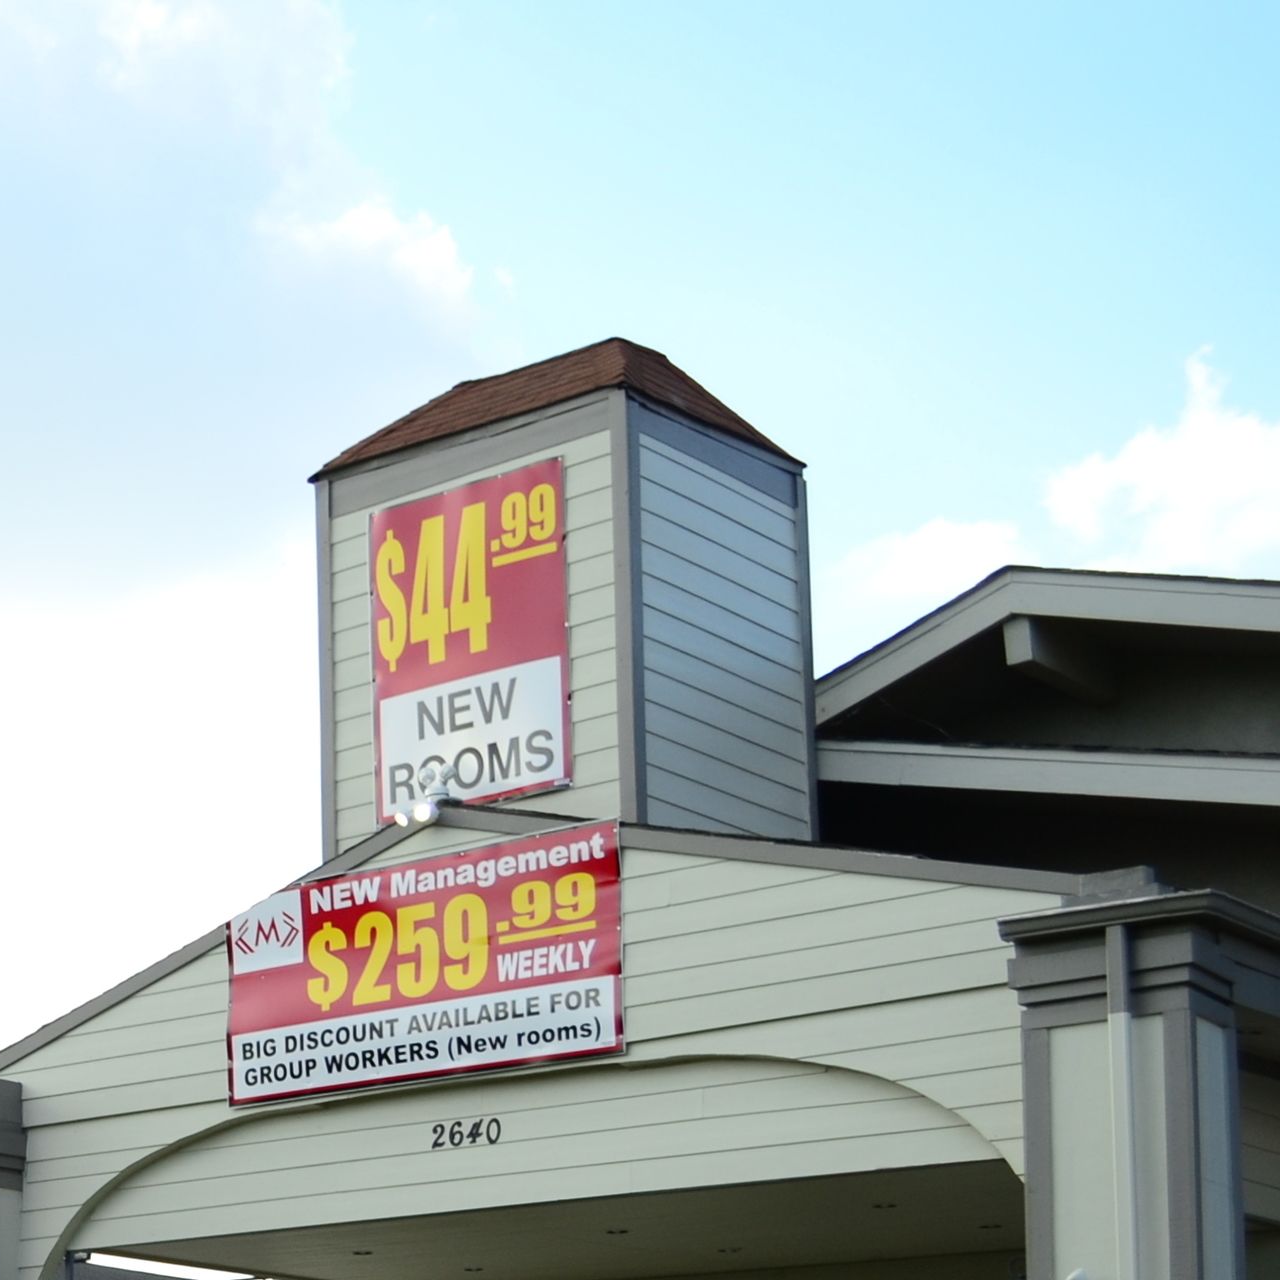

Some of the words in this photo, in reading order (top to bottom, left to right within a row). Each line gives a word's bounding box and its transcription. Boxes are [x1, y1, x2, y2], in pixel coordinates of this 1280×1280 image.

[417, 677, 517, 740] NEW
[309, 876, 381, 914] NEW
[389, 832, 606, 898] Management
[496, 939, 597, 983] WEEKLY
[242, 1037, 277, 1061] BIG
[284, 1018, 400, 1054] DISCOUNT
[407, 996, 540, 1035] AVAILABLE
[549, 988, 601, 1014] FOR
[244, 1059, 318, 1087] GROUP
[325, 1040, 440, 1074] WORKERS
[447, 1032, 508, 1062] (New
[516, 1017, 602, 1048] rooms)
[431, 1117, 502, 1149] 2640
